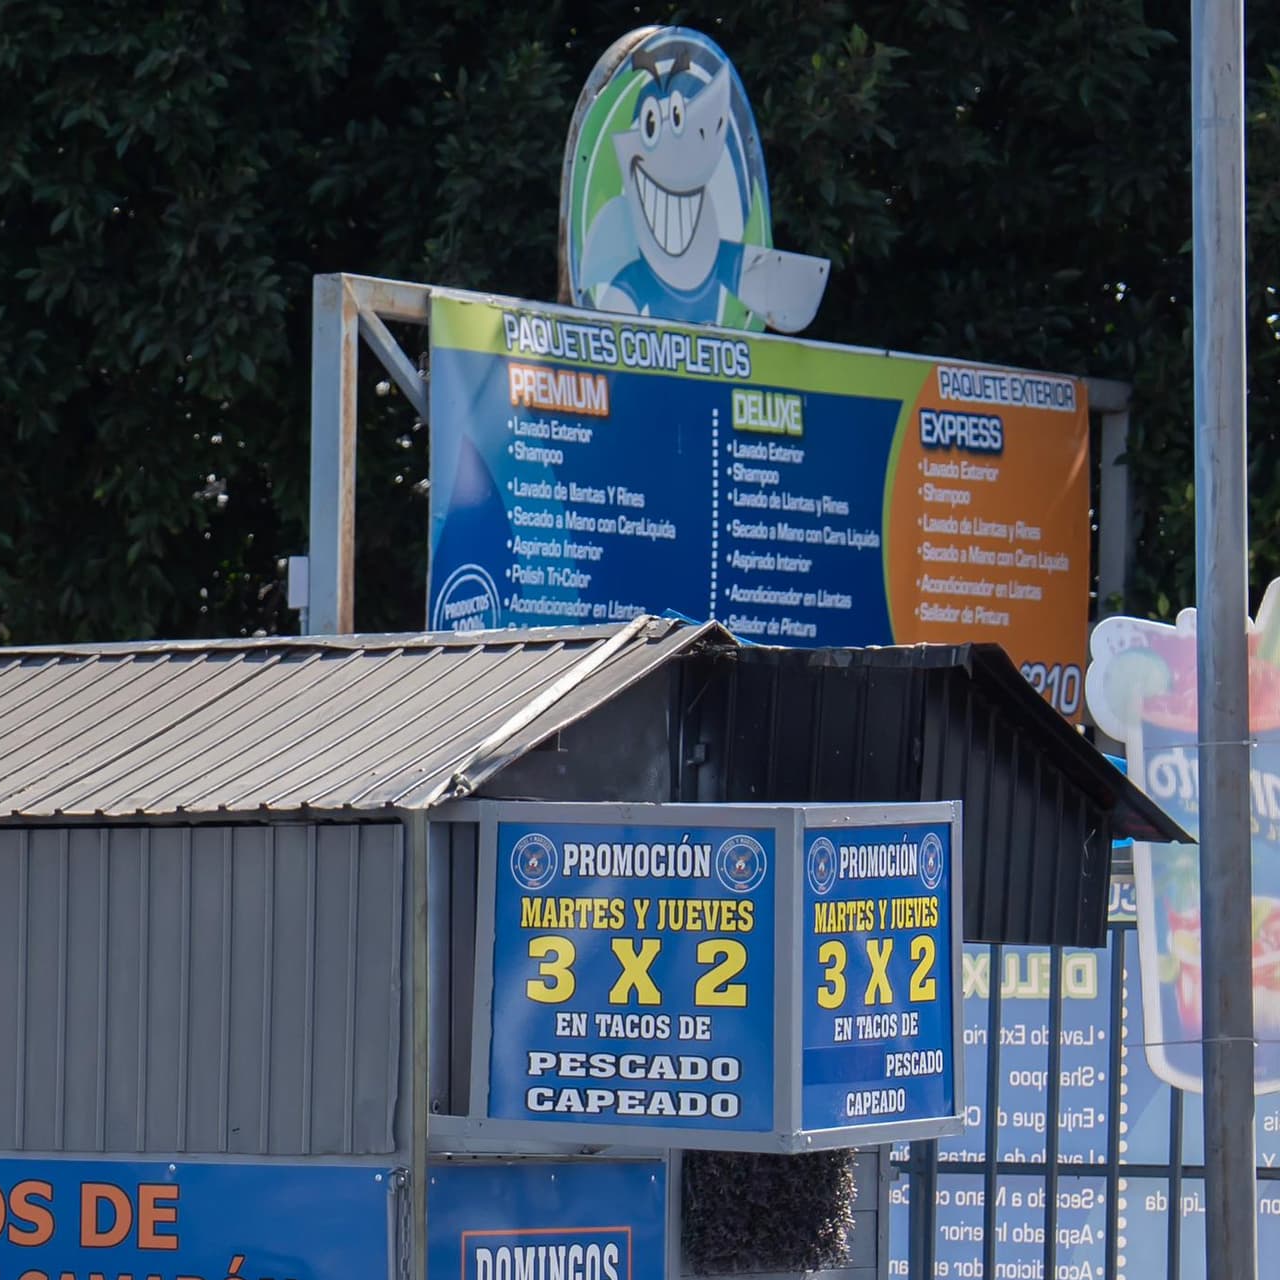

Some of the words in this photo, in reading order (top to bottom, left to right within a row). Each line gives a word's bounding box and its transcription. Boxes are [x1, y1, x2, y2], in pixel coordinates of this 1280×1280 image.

[503, 314, 617, 365] PAQUETES
[620, 327, 749, 377] COMPLETOS
[511, 366, 608, 411] PREMIUM
[940, 370, 1007, 400] PAQUETE
[1011, 379, 1073, 408] EXTERIOR
[734, 392, 801, 431] DELUXE
[514, 416, 550, 438] Lavado
[551, 421, 592, 443] Exterior
[921, 411, 1002, 449] EXPRESS
[514, 441, 563, 467] Shampoo
[733, 439, 767, 460] Lavado
[769, 442, 804, 463] Exterior
[733, 462, 779, 488] Shampoo
[514, 477, 551, 498] Lavado
[554, 482, 567, 500] de
[617, 487, 645, 508] Rines
[733, 488, 768, 508] Lavado
[769, 491, 781, 509] de
[514, 506, 554, 528] Secado
[565, 510, 595, 532] Mano
[597, 519, 616, 533] con
[732, 519, 768, 539] Secado
[777, 522, 804, 542] Mano
[806, 530, 822, 543] con
[512, 535, 562, 559] Aspirado
[563, 540, 603, 561] Interior
[732, 550, 775, 573] Aspirado
[776, 553, 812, 572] Interior
[512, 564, 544, 586] Polish
[547, 567, 591, 588] Tri-Color
[445, 593, 490, 620] PRODUCTOS
[509, 593, 591, 617] Acondicionador
[593, 603, 606, 617] en
[730, 584, 803, 605] Acondicionador
[804, 593, 816, 606] en
[728, 614, 767, 634] Sellador
[768, 617, 779, 635] de
[781, 617, 816, 637] Pintura
[562, 834, 711, 878] PROMOCIÓN
[839, 834, 918, 879] PROMOCIÓN
[521, 897, 625, 930] MARTES
[633, 899, 649, 930] Y
[657, 899, 754, 932] JUEVES
[814, 900, 874, 934] MARTES
[878, 899, 888, 931] Y
[891, 896, 938, 929] JUEVES
[526, 935, 576, 1004] 3
[608, 938, 662, 1005] X
[695, 938, 748, 1007] 2
[817, 940, 847, 1010] 3
[864, 938, 894, 1005] X
[909, 934, 937, 1003] 2
[556, 1013, 587, 1037] EN
[595, 1014, 670, 1039] TACOS
[679, 1016, 711, 1040] DE
[834, 1016, 852, 1042] EN
[856, 1013, 897, 1040] TACOS
[901, 1011, 919, 1037] DE
[528, 1052, 740, 1082] PESCADO
[886, 1050, 944, 1078] PESCADO
[527, 1087, 740, 1118] CAPEADO
[846, 1088, 906, 1117] CAPEADO
[79, 1182, 180, 1250] DE
